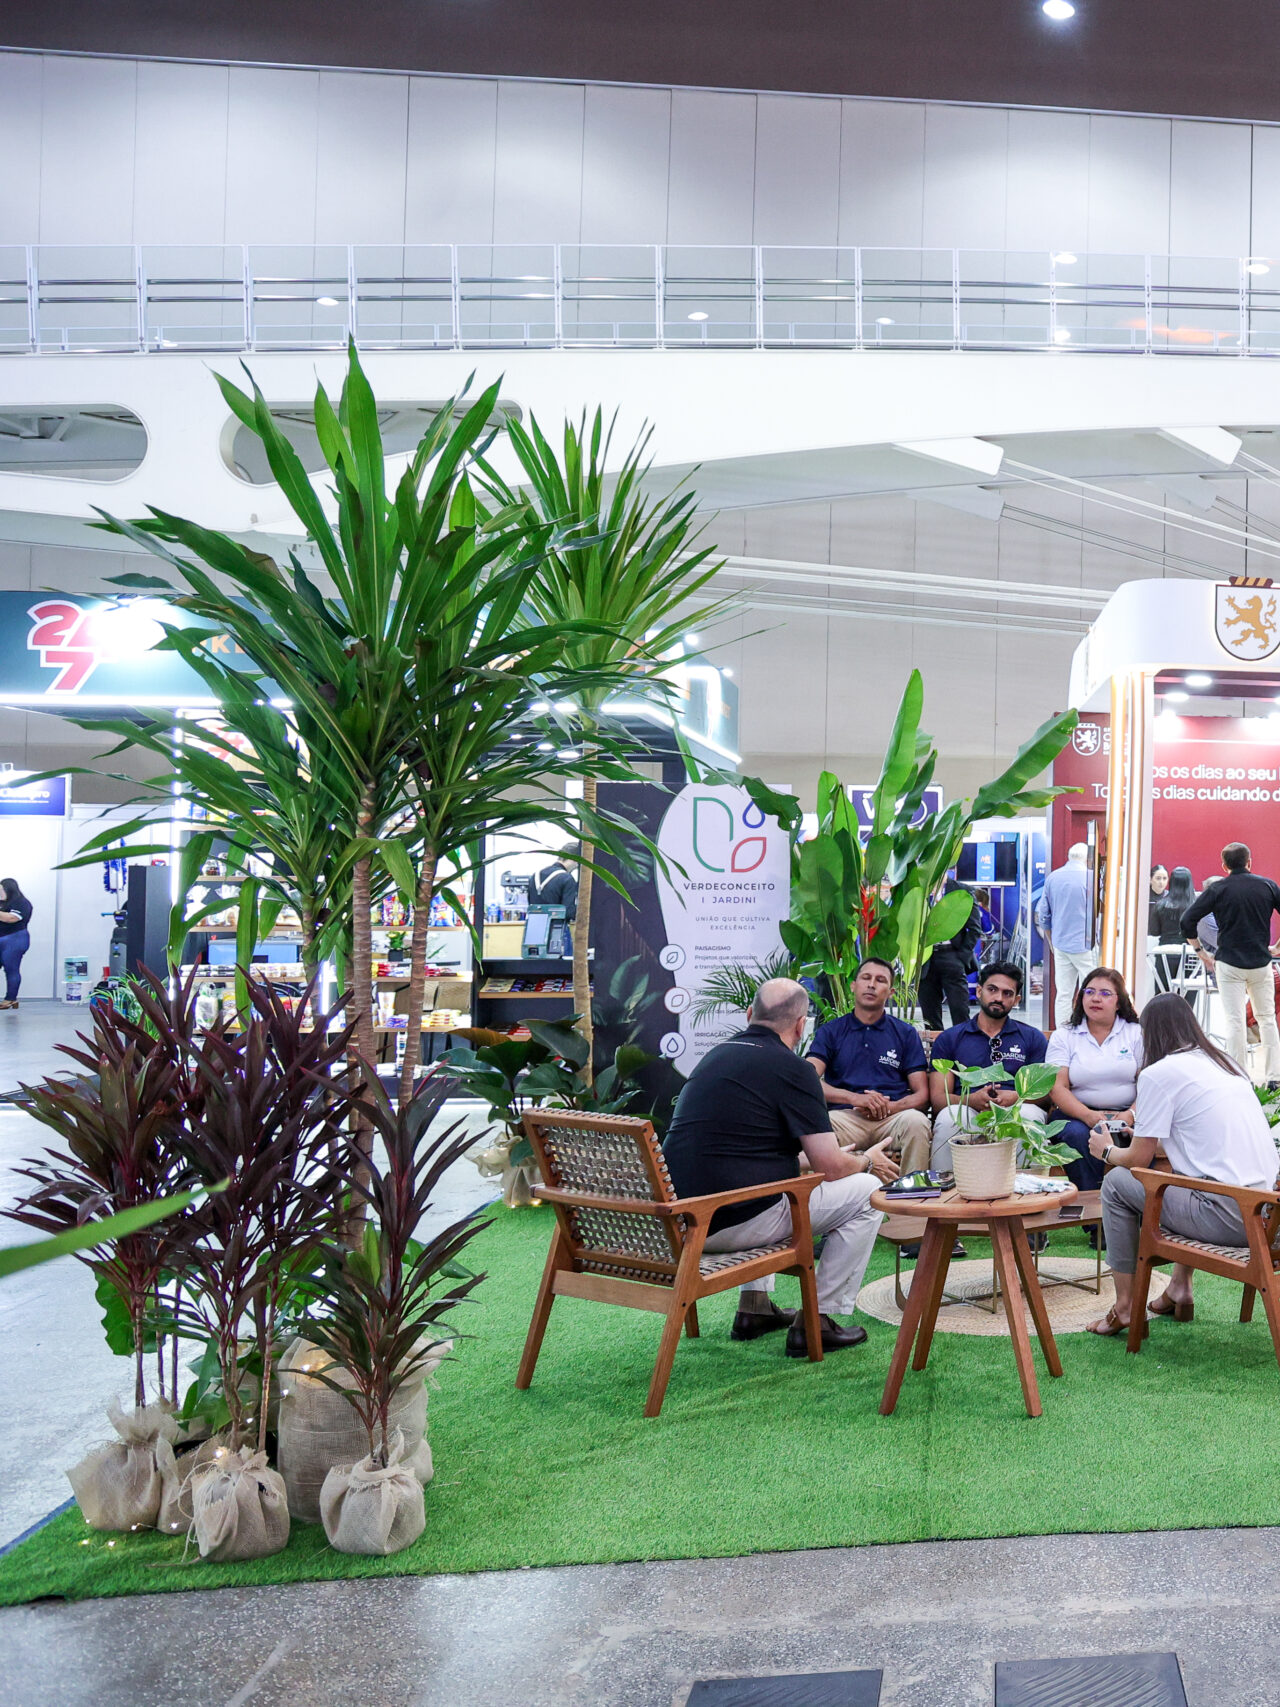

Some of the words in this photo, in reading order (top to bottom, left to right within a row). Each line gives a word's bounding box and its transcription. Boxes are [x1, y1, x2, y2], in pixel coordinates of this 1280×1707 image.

[1170, 766, 1190, 779] os
[1191, 764, 1224, 780] dias
[1225, 767, 1246, 780] ao
[1247, 768, 1277, 781] seu
[1163, 785, 1195, 800] dias
[1196, 786, 1270, 802] cuidando
[683, 882, 775, 891] VERDECONCEITO
[712, 896, 757, 904] JARDINI
